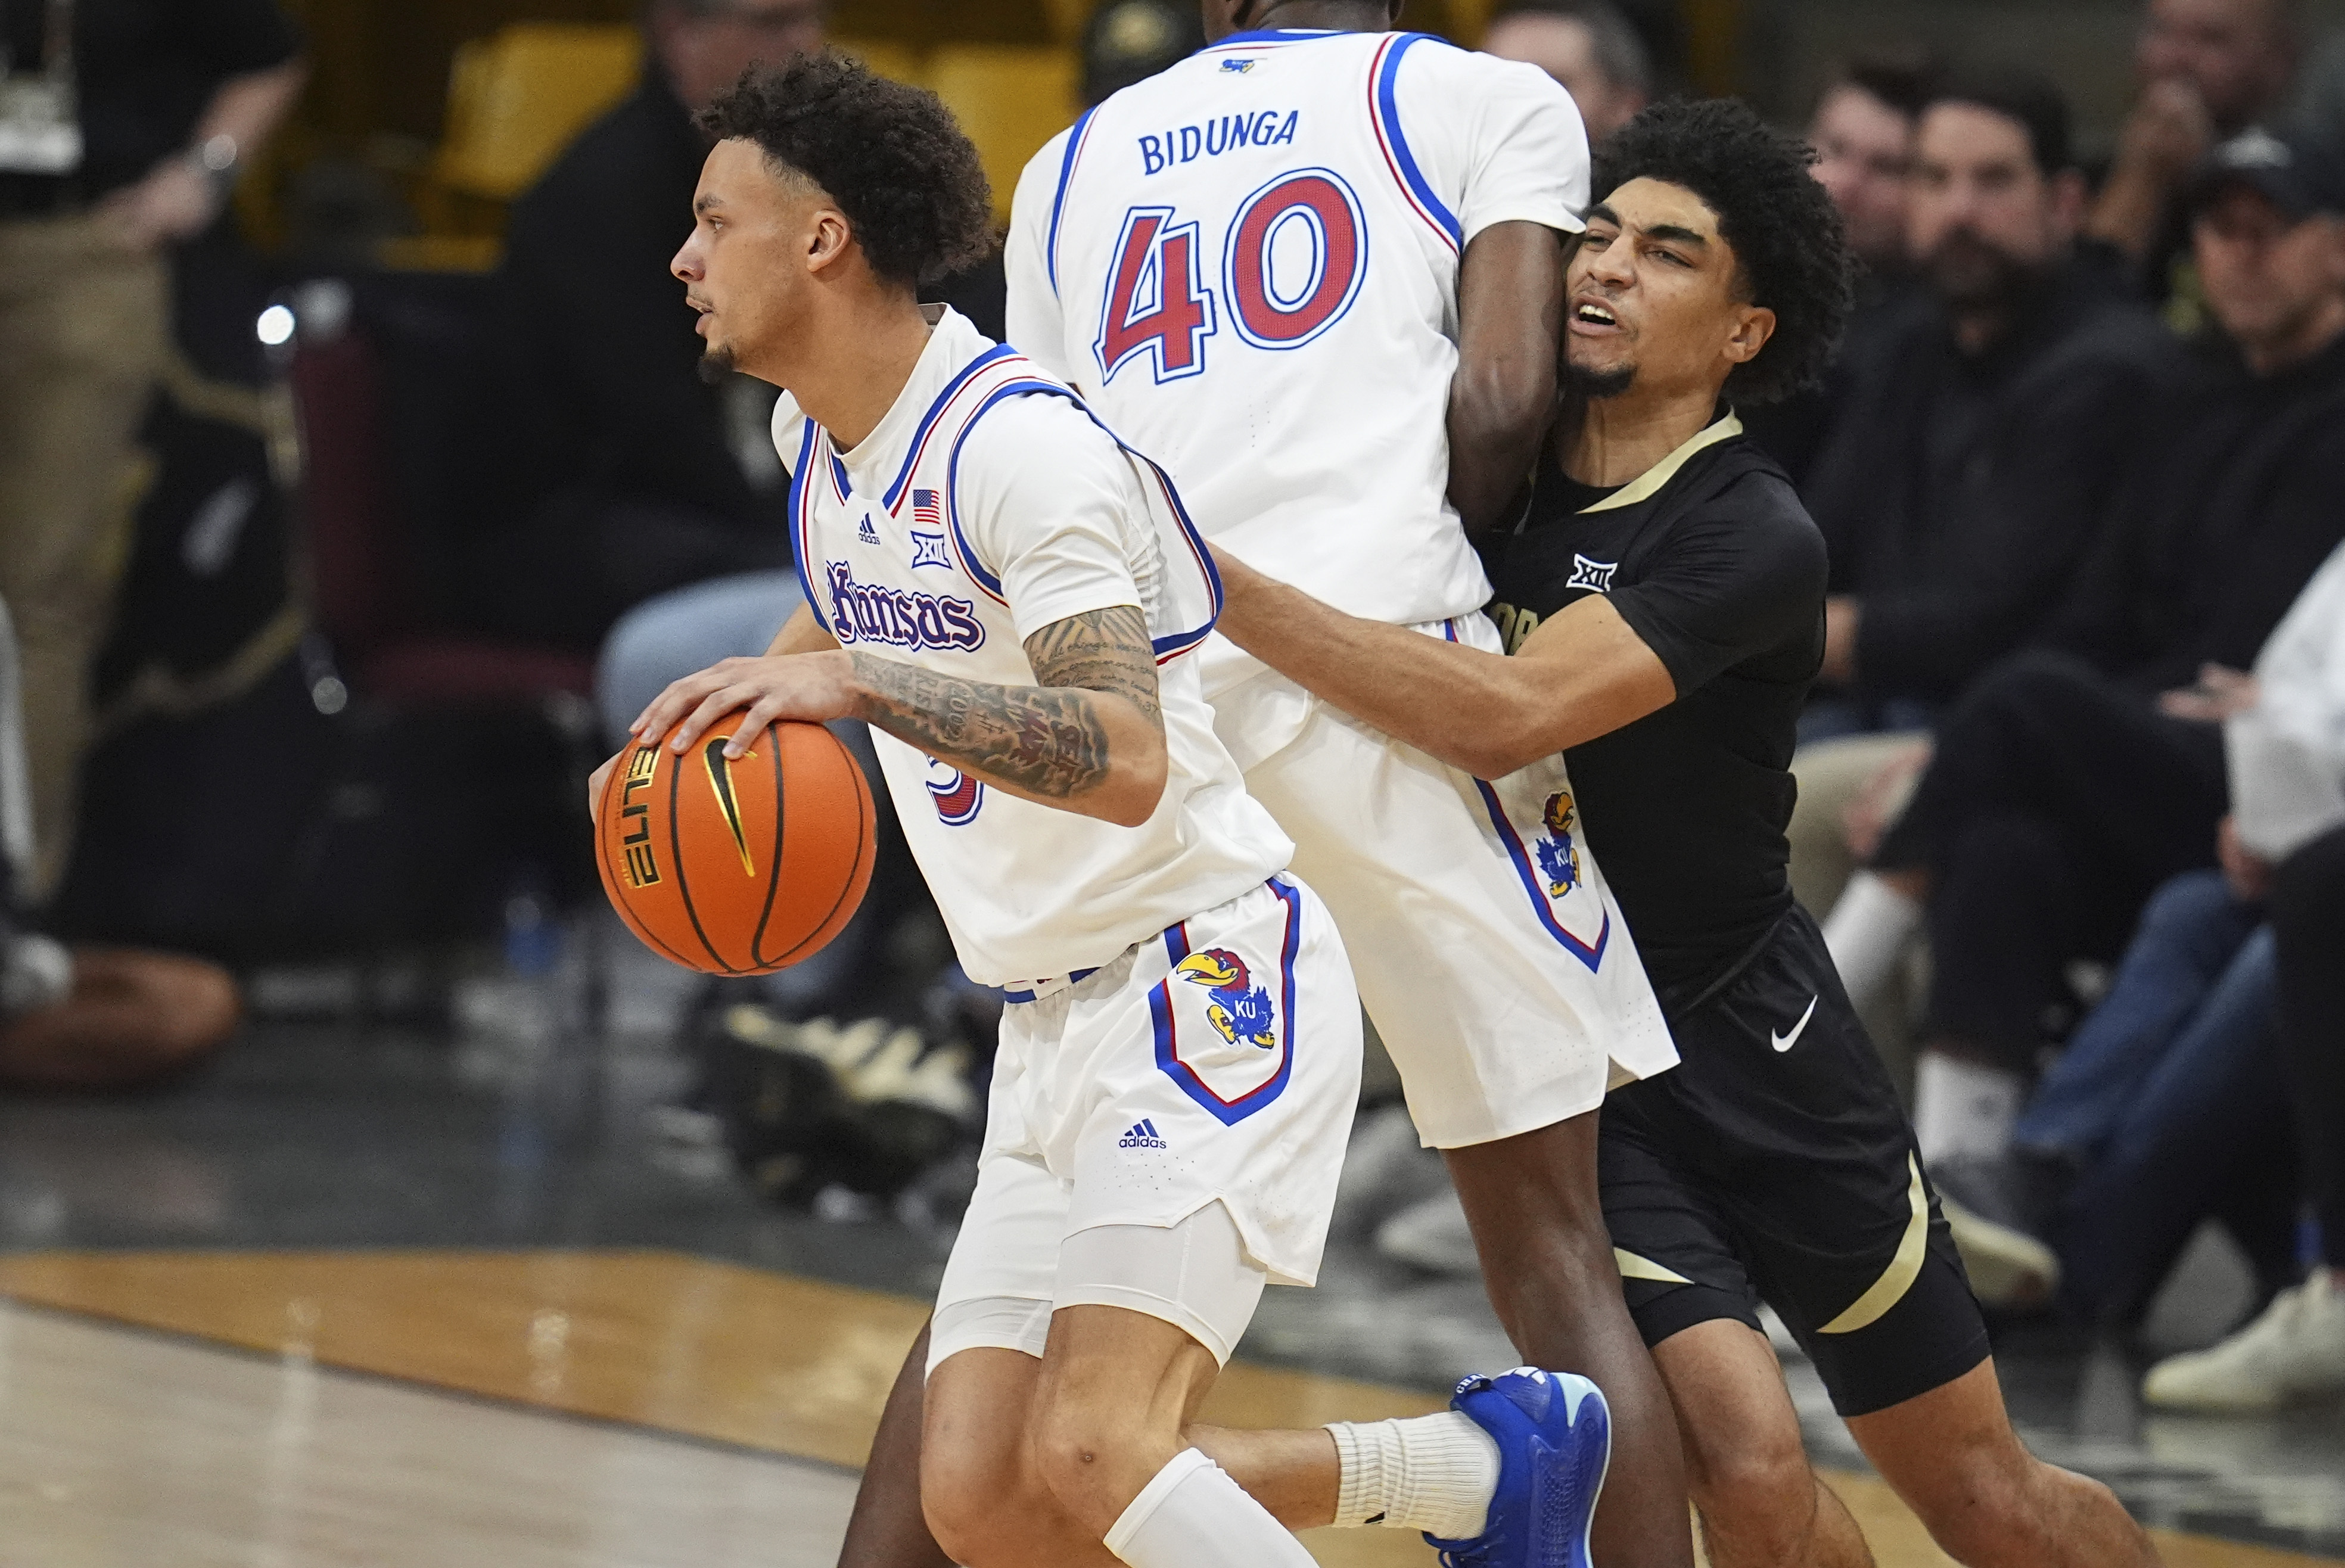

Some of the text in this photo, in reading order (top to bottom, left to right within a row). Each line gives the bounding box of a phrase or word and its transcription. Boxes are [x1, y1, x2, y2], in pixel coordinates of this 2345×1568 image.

[1139, 110, 1299, 176] BIDUNGA
[1093, 167, 1368, 386] 40
[859, 533, 880, 545] adidas
[826, 560, 985, 652] Kansas
[623, 746, 663, 888] ELITE
[1554, 847, 1569, 867] KU
[1234, 1000, 1256, 1019] KU
[1119, 1135, 1167, 1149] adidas
